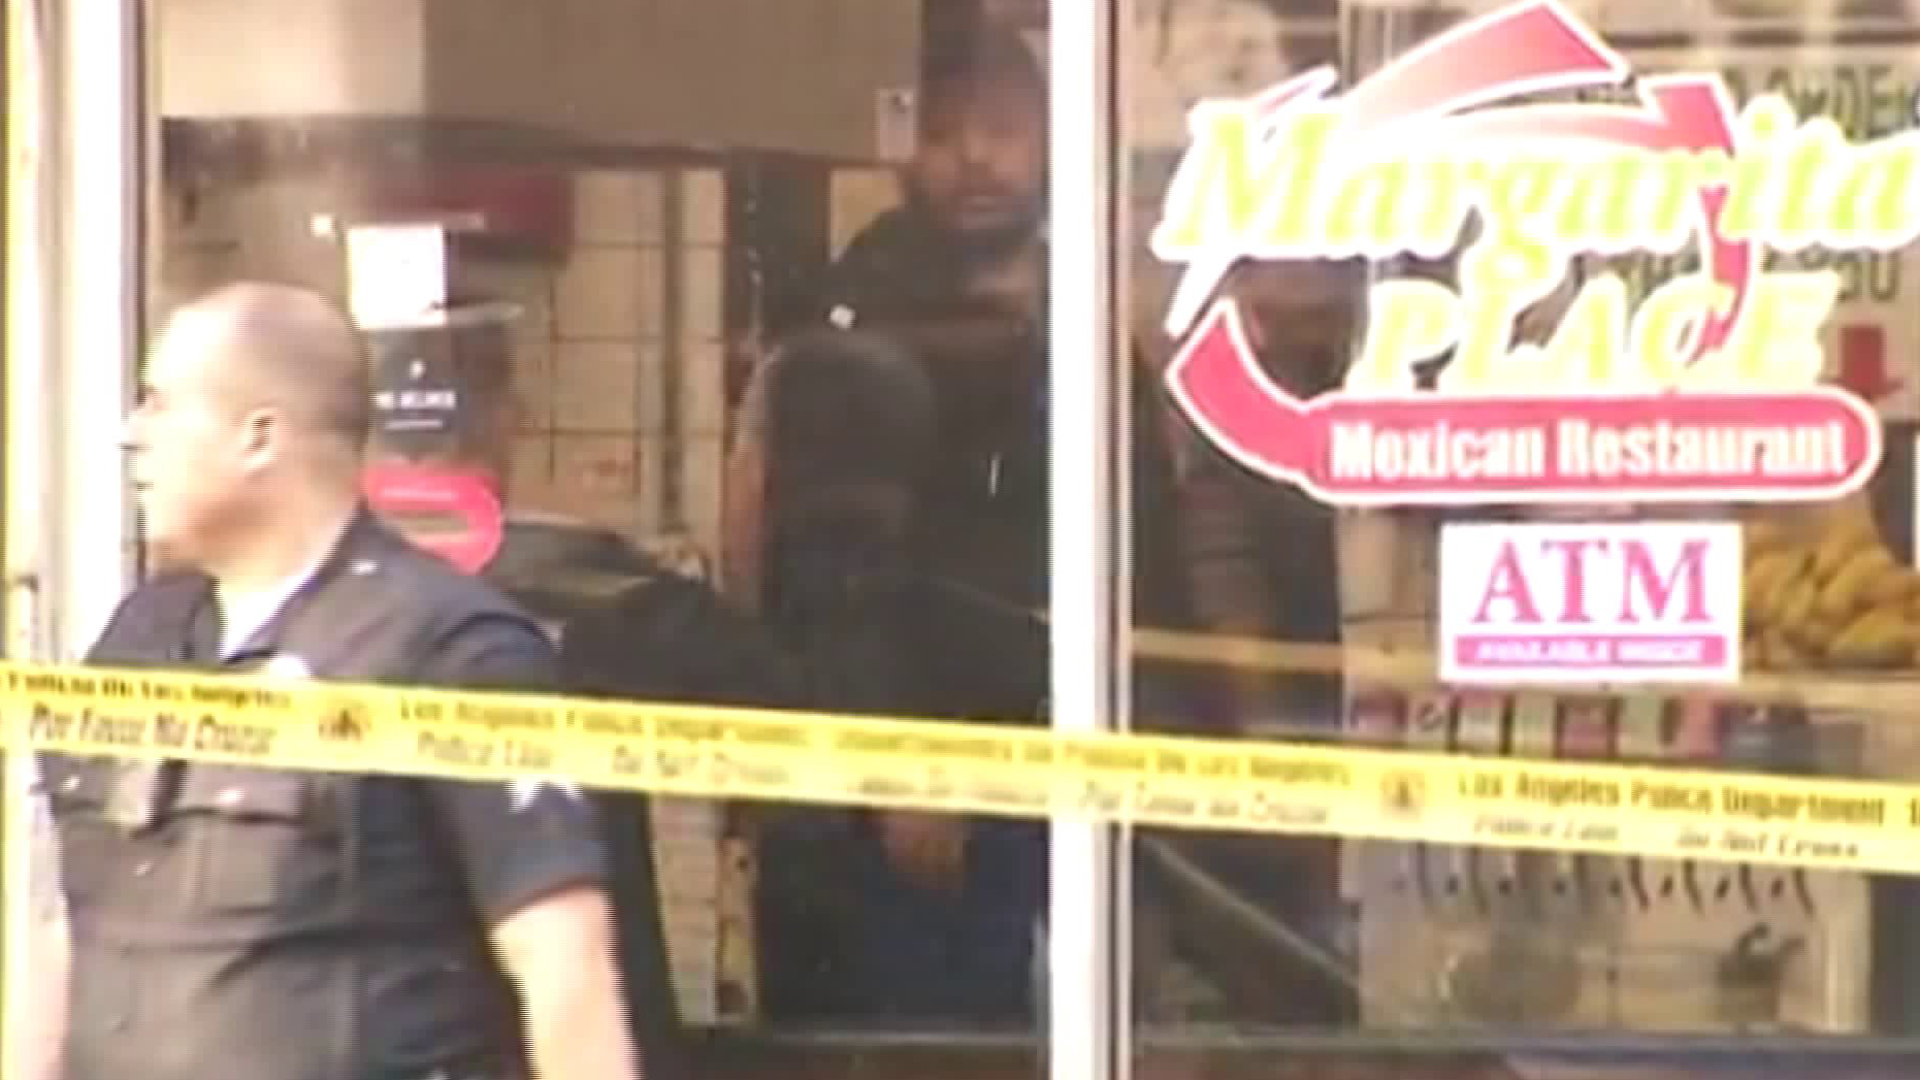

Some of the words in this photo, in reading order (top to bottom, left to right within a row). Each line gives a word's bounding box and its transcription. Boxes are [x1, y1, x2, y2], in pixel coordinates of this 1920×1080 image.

[1158, 98, 1918, 288] Margarita
[1358, 272, 1840, 388] PLACE
[1330, 421, 1546, 480] Mexican
[1556, 419, 1846, 477] Restaurant
[1470, 538, 1716, 625] ATM
[29, 701, 74, 742] Por
[1458, 772, 1504, 798] Los
[1515, 771, 1621, 808] Angeles
[1721, 785, 1888, 828] Department
